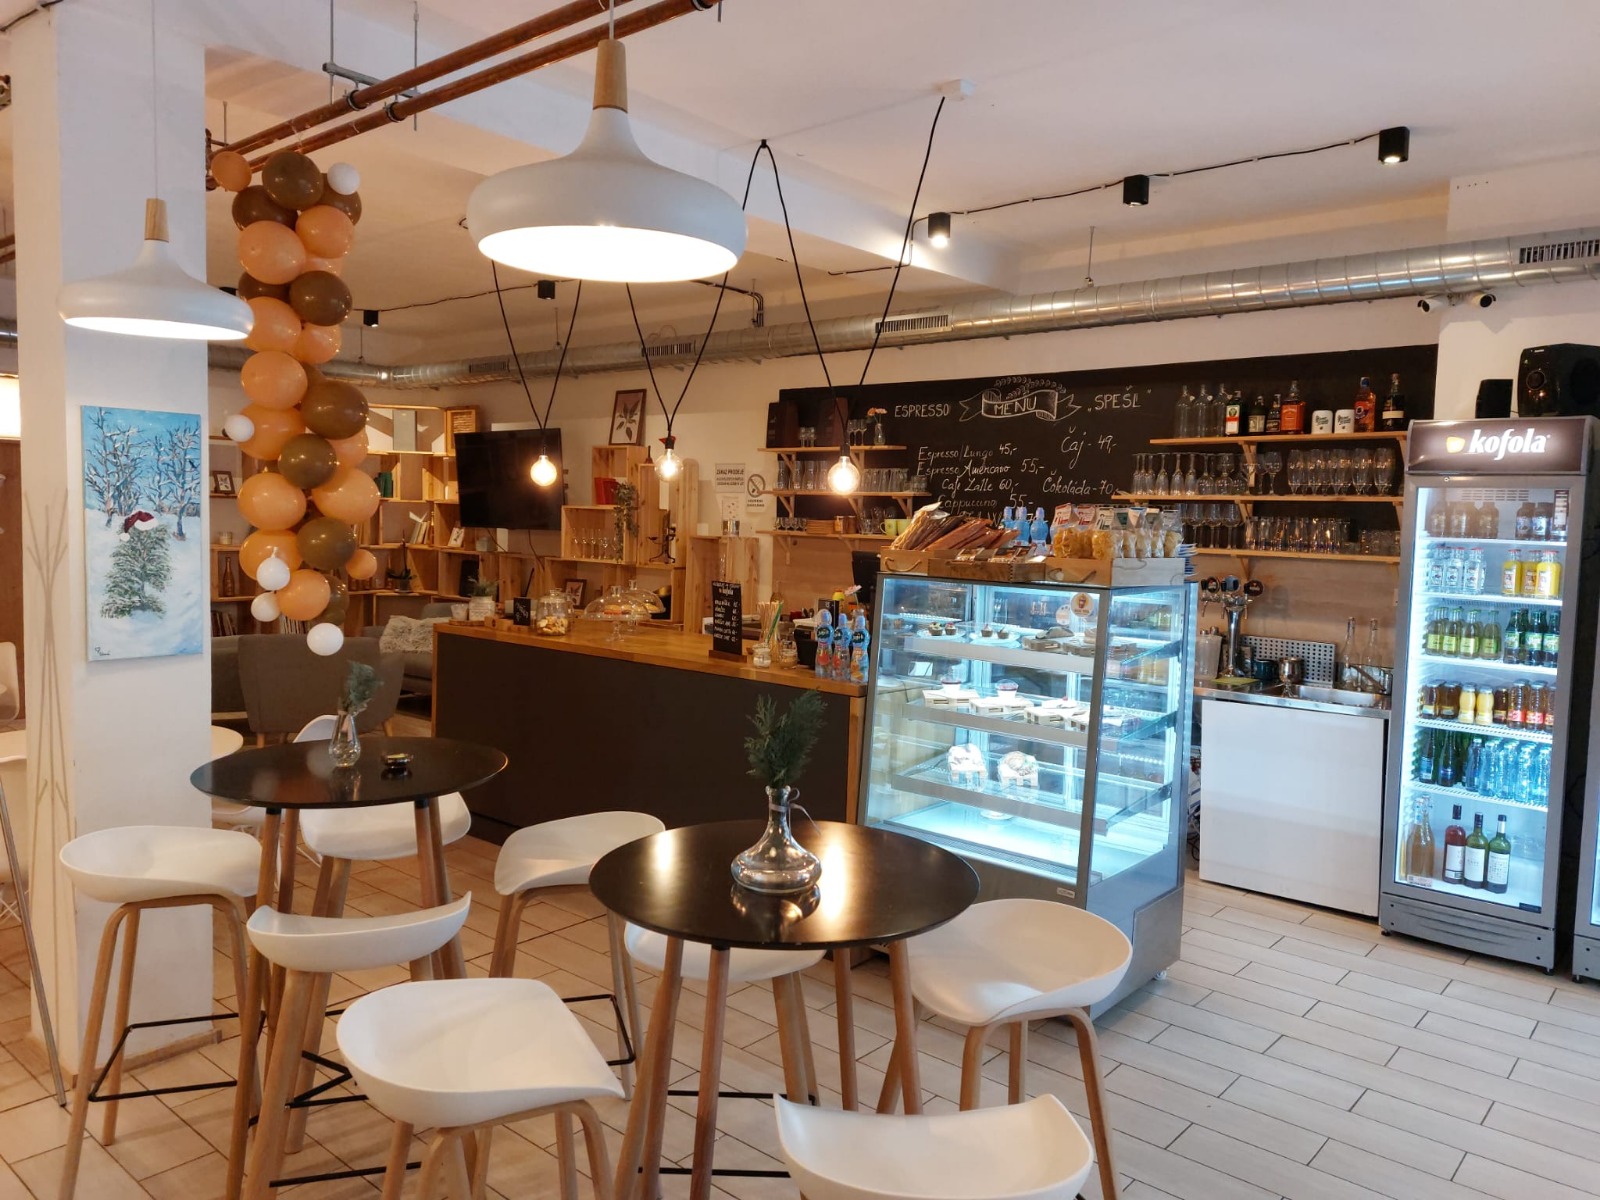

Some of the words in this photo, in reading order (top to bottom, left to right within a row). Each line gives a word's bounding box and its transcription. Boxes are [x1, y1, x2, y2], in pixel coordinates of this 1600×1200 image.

[894, 403, 950, 418] ESPRESSO
[994, 395, 1037, 415] MENU
[1060, 426, 1087, 470] Čaj
[1467, 427, 1548, 461] kofola
[916, 461, 961, 480] Espresso
